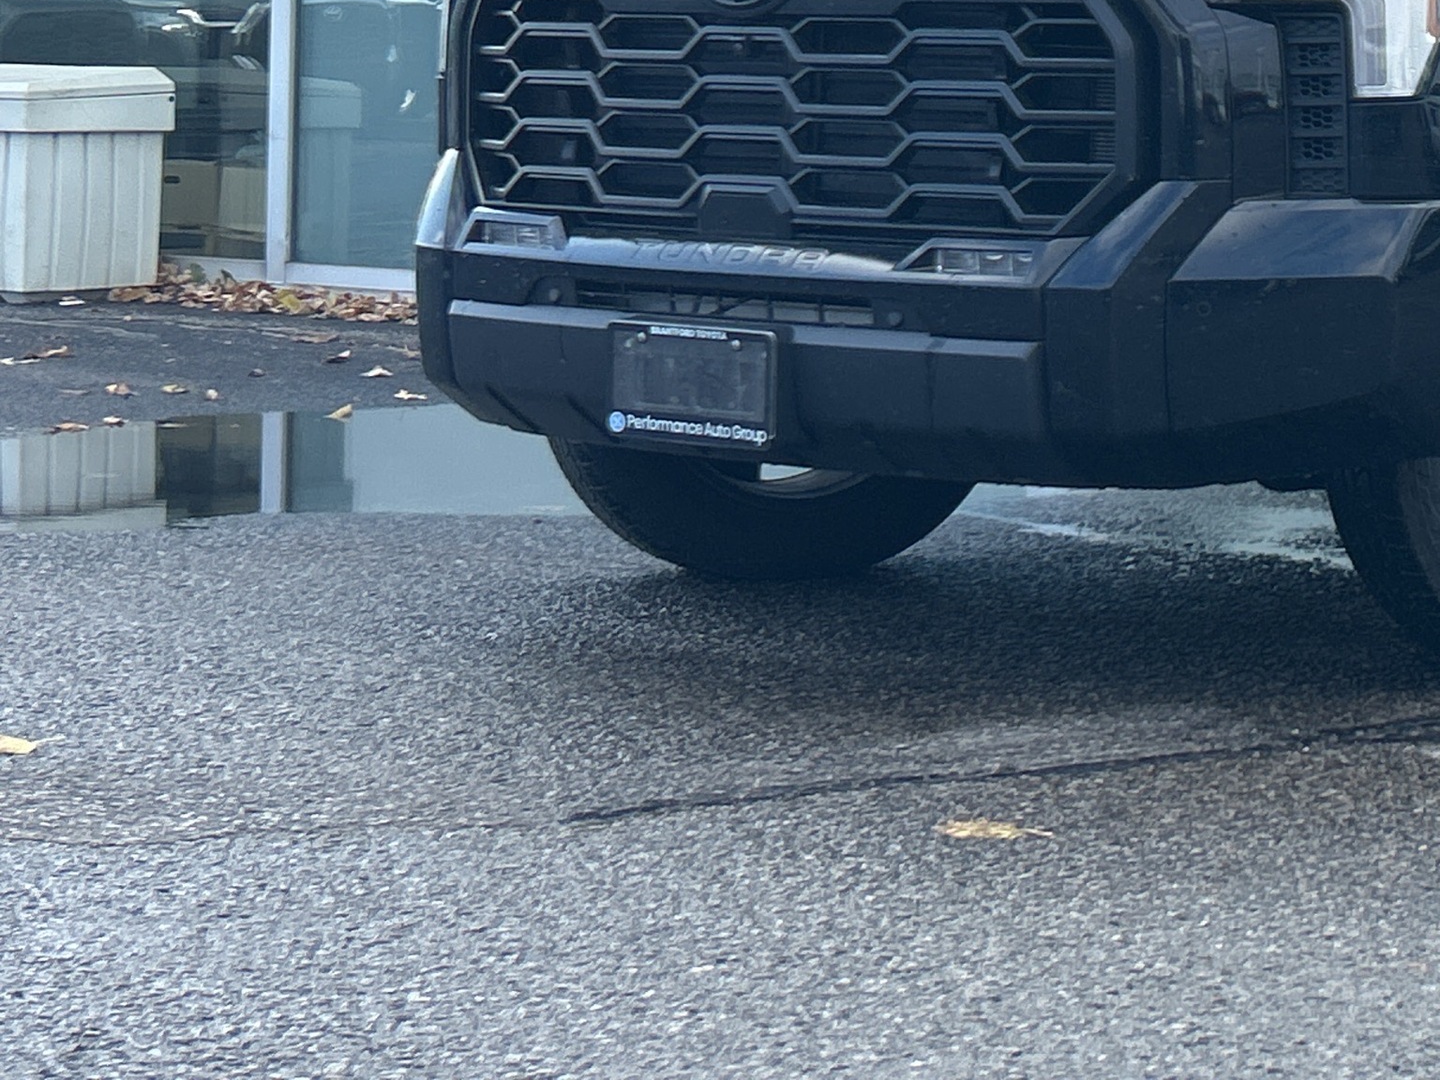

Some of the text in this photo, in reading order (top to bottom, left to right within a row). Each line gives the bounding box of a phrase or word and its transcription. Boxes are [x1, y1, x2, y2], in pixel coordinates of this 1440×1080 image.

[630, 239, 831, 271] TUNDRA
[626, 414, 768, 447] Performance Auto Group
